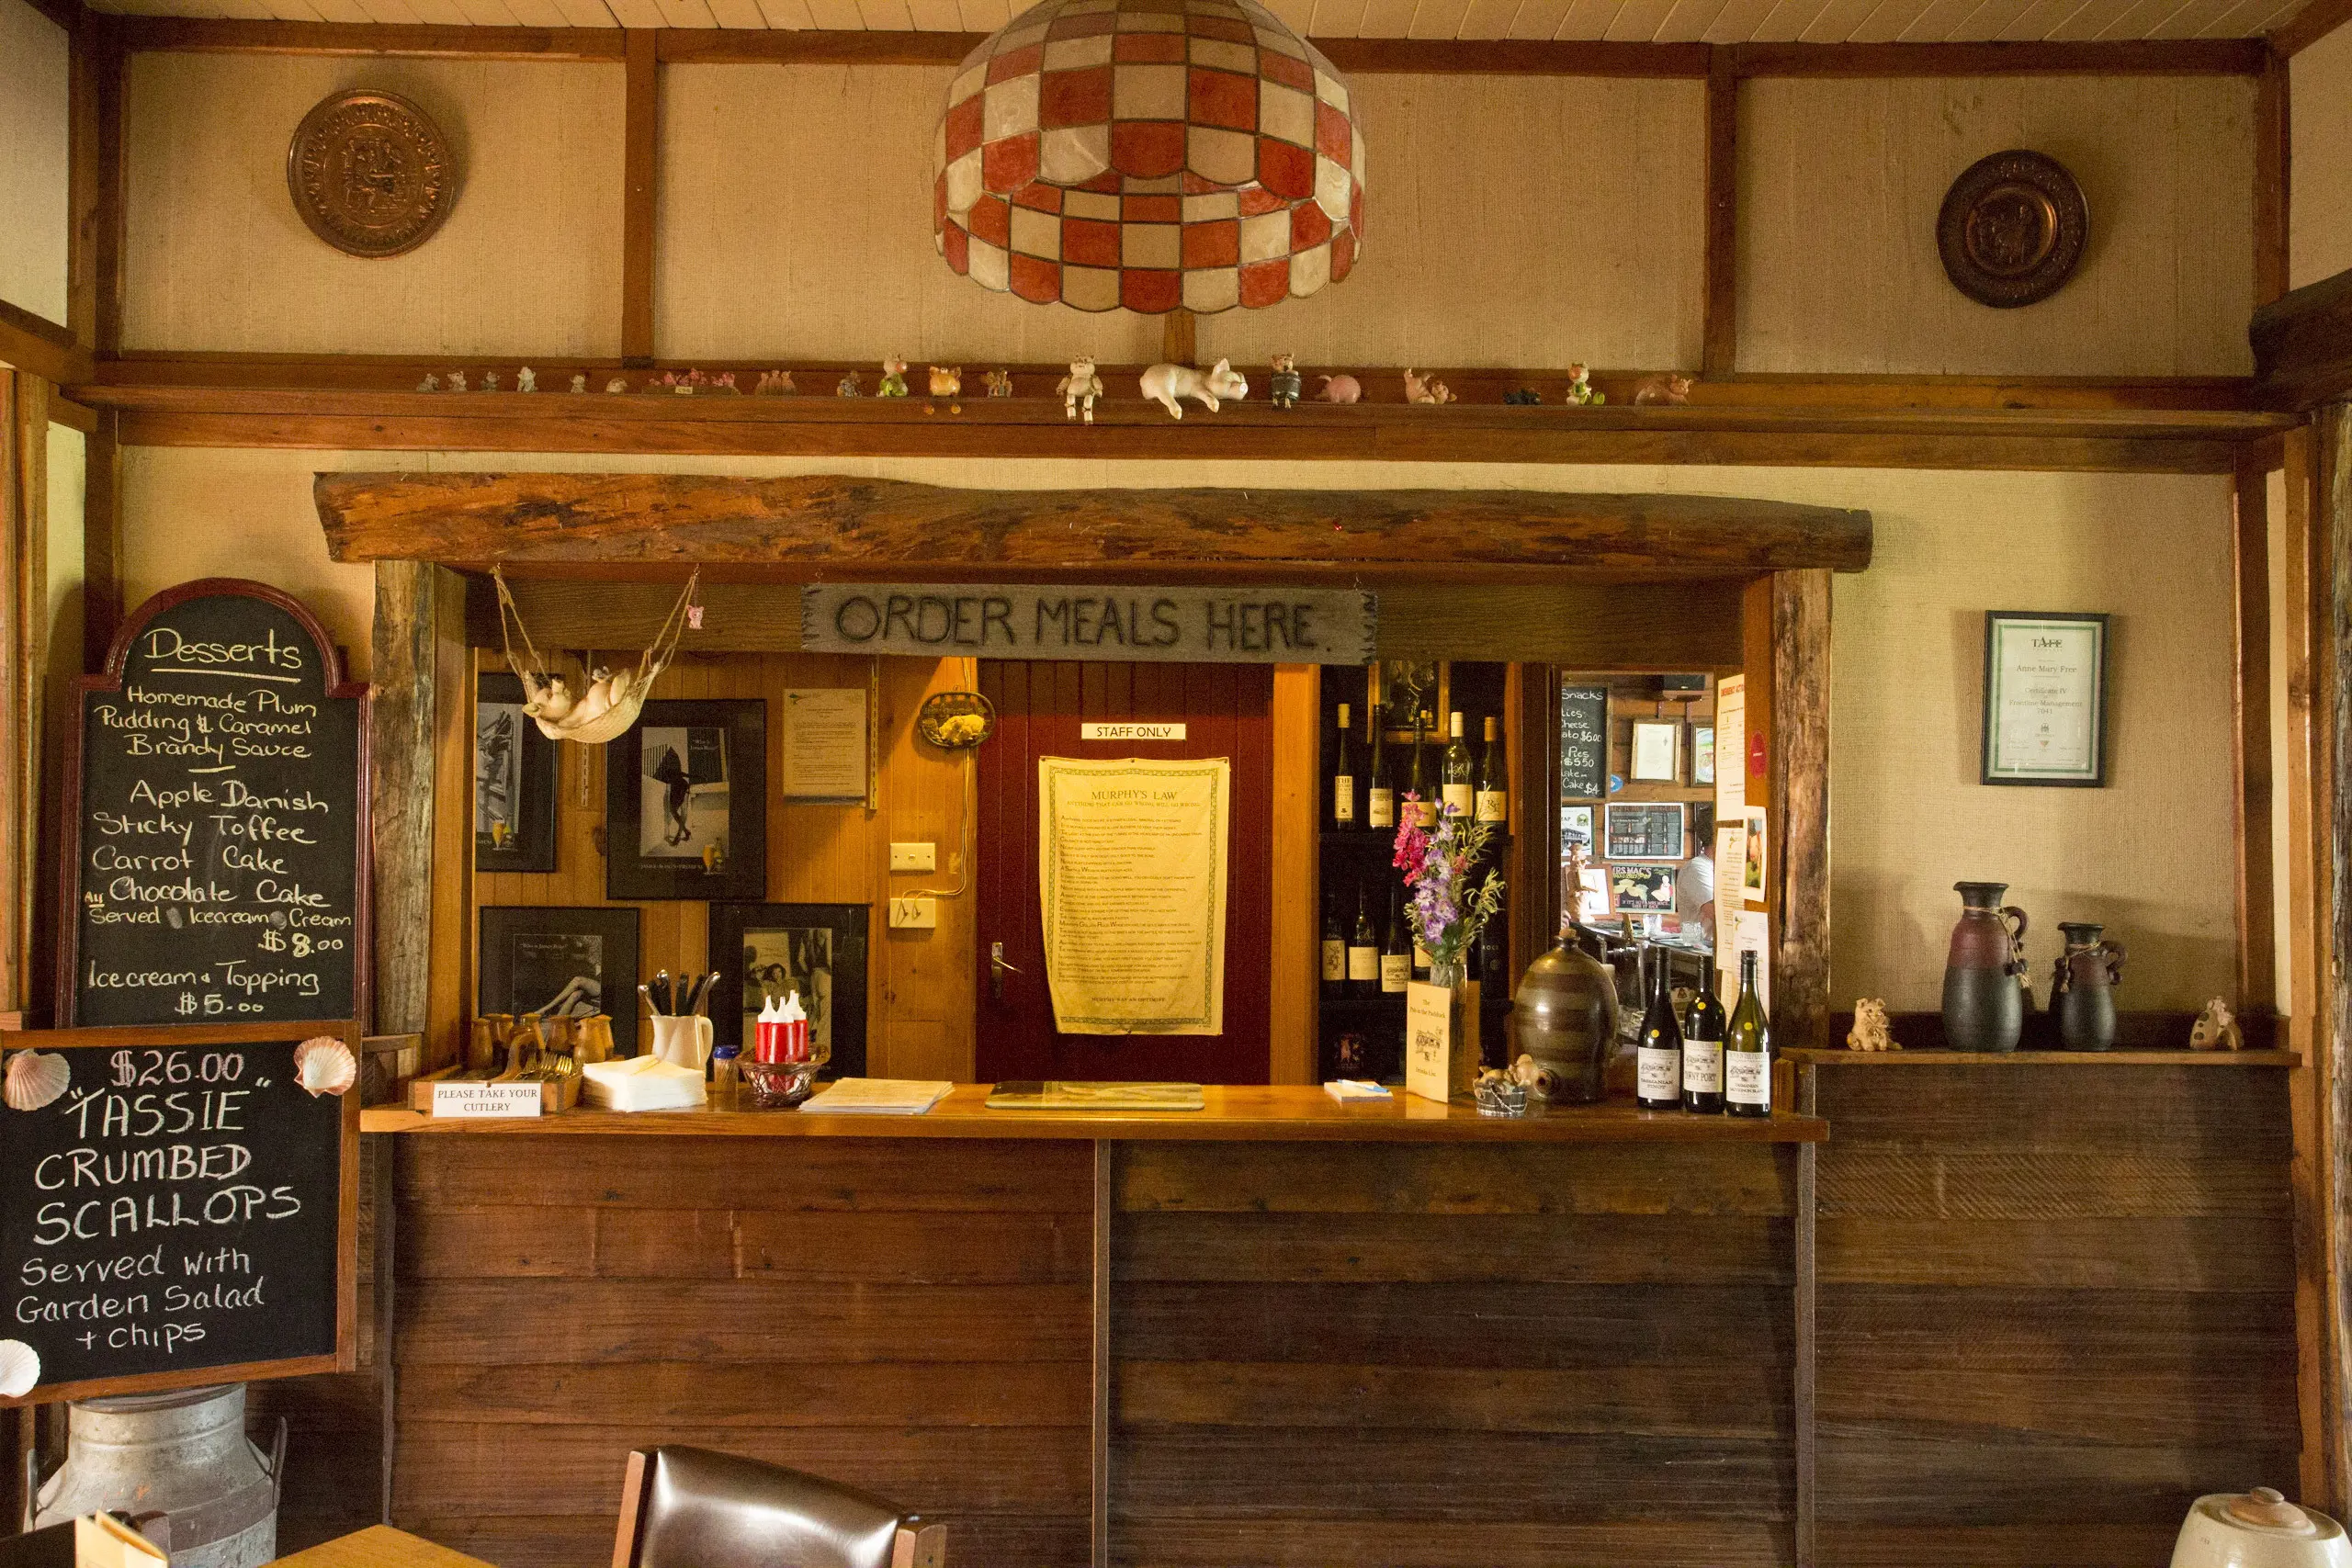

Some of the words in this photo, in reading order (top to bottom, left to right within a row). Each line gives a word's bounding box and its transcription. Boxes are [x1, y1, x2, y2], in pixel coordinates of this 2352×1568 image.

[836, 594, 1012, 645] ORDER
[1035, 597, 1182, 647] MEALS
[144, 627, 302, 671] Desserts
[2031, 636, 2063, 649] TAFE
[2016, 665, 2036, 673] Anne
[2038, 665, 2058, 674] Mary
[127, 685, 246, 713] Homemade
[248, 689, 317, 717] Plum
[1562, 688, 1603, 700] Snacks
[2040, 700, 2083, 709] Management
[94, 705, 190, 742] Pudding
[220, 713, 311, 735] Caramel
[1097, 727, 1133, 737] STAFF
[1136, 727, 1171, 737] ONLY
[124, 734, 222, 763] Brandy
[232, 738, 311, 758] Sauce
[130, 779, 217, 809] Apple
[220, 779, 329, 813] Danish
[1091, 790, 1148, 800] MURPHY'S
[1153, 791, 1178, 800] LAW
[1563, 777, 1584, 789] Cake
[93, 811, 193, 846] Sticky
[209, 814, 317, 844] Toffee
[93, 844, 194, 871] Carrot
[222, 845, 288, 874] Cake
[1627, 867, 1652, 876] MAC'S
[109, 876, 238, 903] Chocolate
[256, 879, 332, 908] Cake
[89, 906, 161, 924] Served
[189, 907, 269, 925] Icecream
[289, 908, 351, 927] Cream
[215, 960, 320, 996] Topping
[109, 1049, 244, 1088] $26.00
[1701, 1072, 1716, 1081] PORT
[438, 1089, 475, 1099] PLEASE
[478, 1089, 506, 1099] TAKE
[509, 1089, 537, 1098] YOUR
[464, 1102, 511, 1111] CUTLERY
[34, 1144, 252, 1190] CRUMBED
[33, 1185, 301, 1246] SCALLOPS
[20, 1244, 165, 1286] Served
[184, 1247, 251, 1277] with
[16, 1292, 149, 1324] Garden
[164, 1276, 266, 1313] Salad
